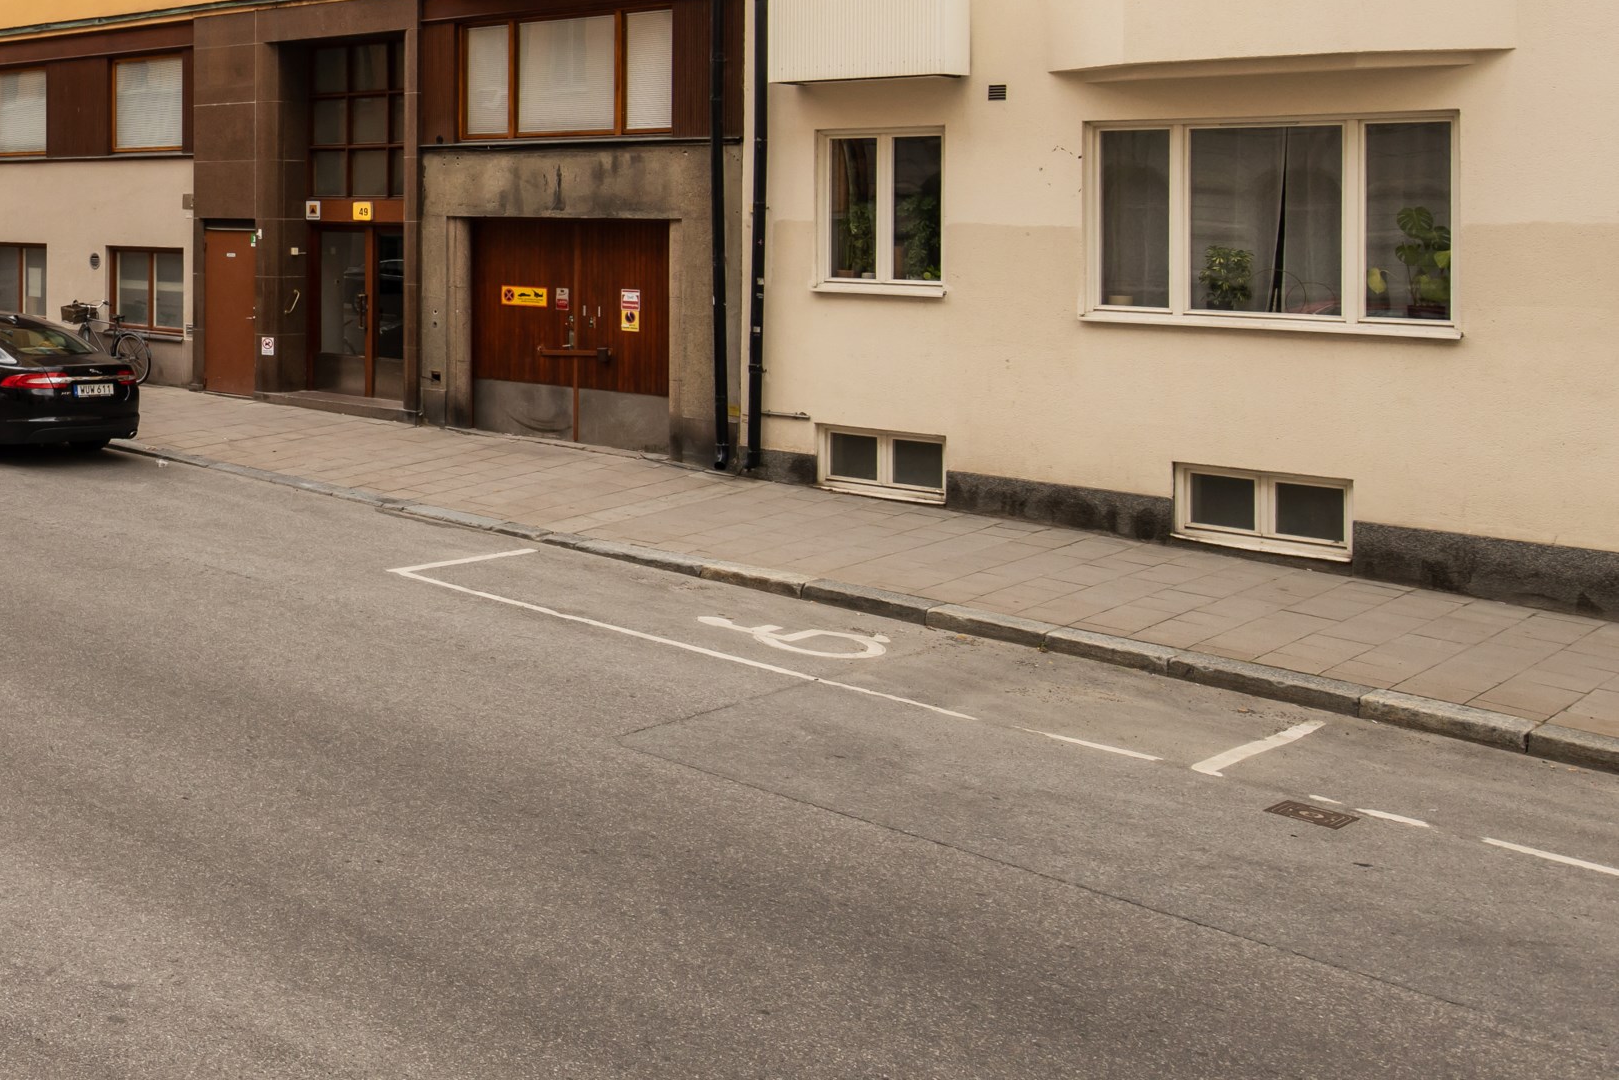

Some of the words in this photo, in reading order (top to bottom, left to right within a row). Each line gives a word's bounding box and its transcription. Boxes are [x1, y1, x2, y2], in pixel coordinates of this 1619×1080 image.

[358, 207, 369, 216] 49
[80, 385, 95, 394] WUW
[97, 385, 111, 393] 611
